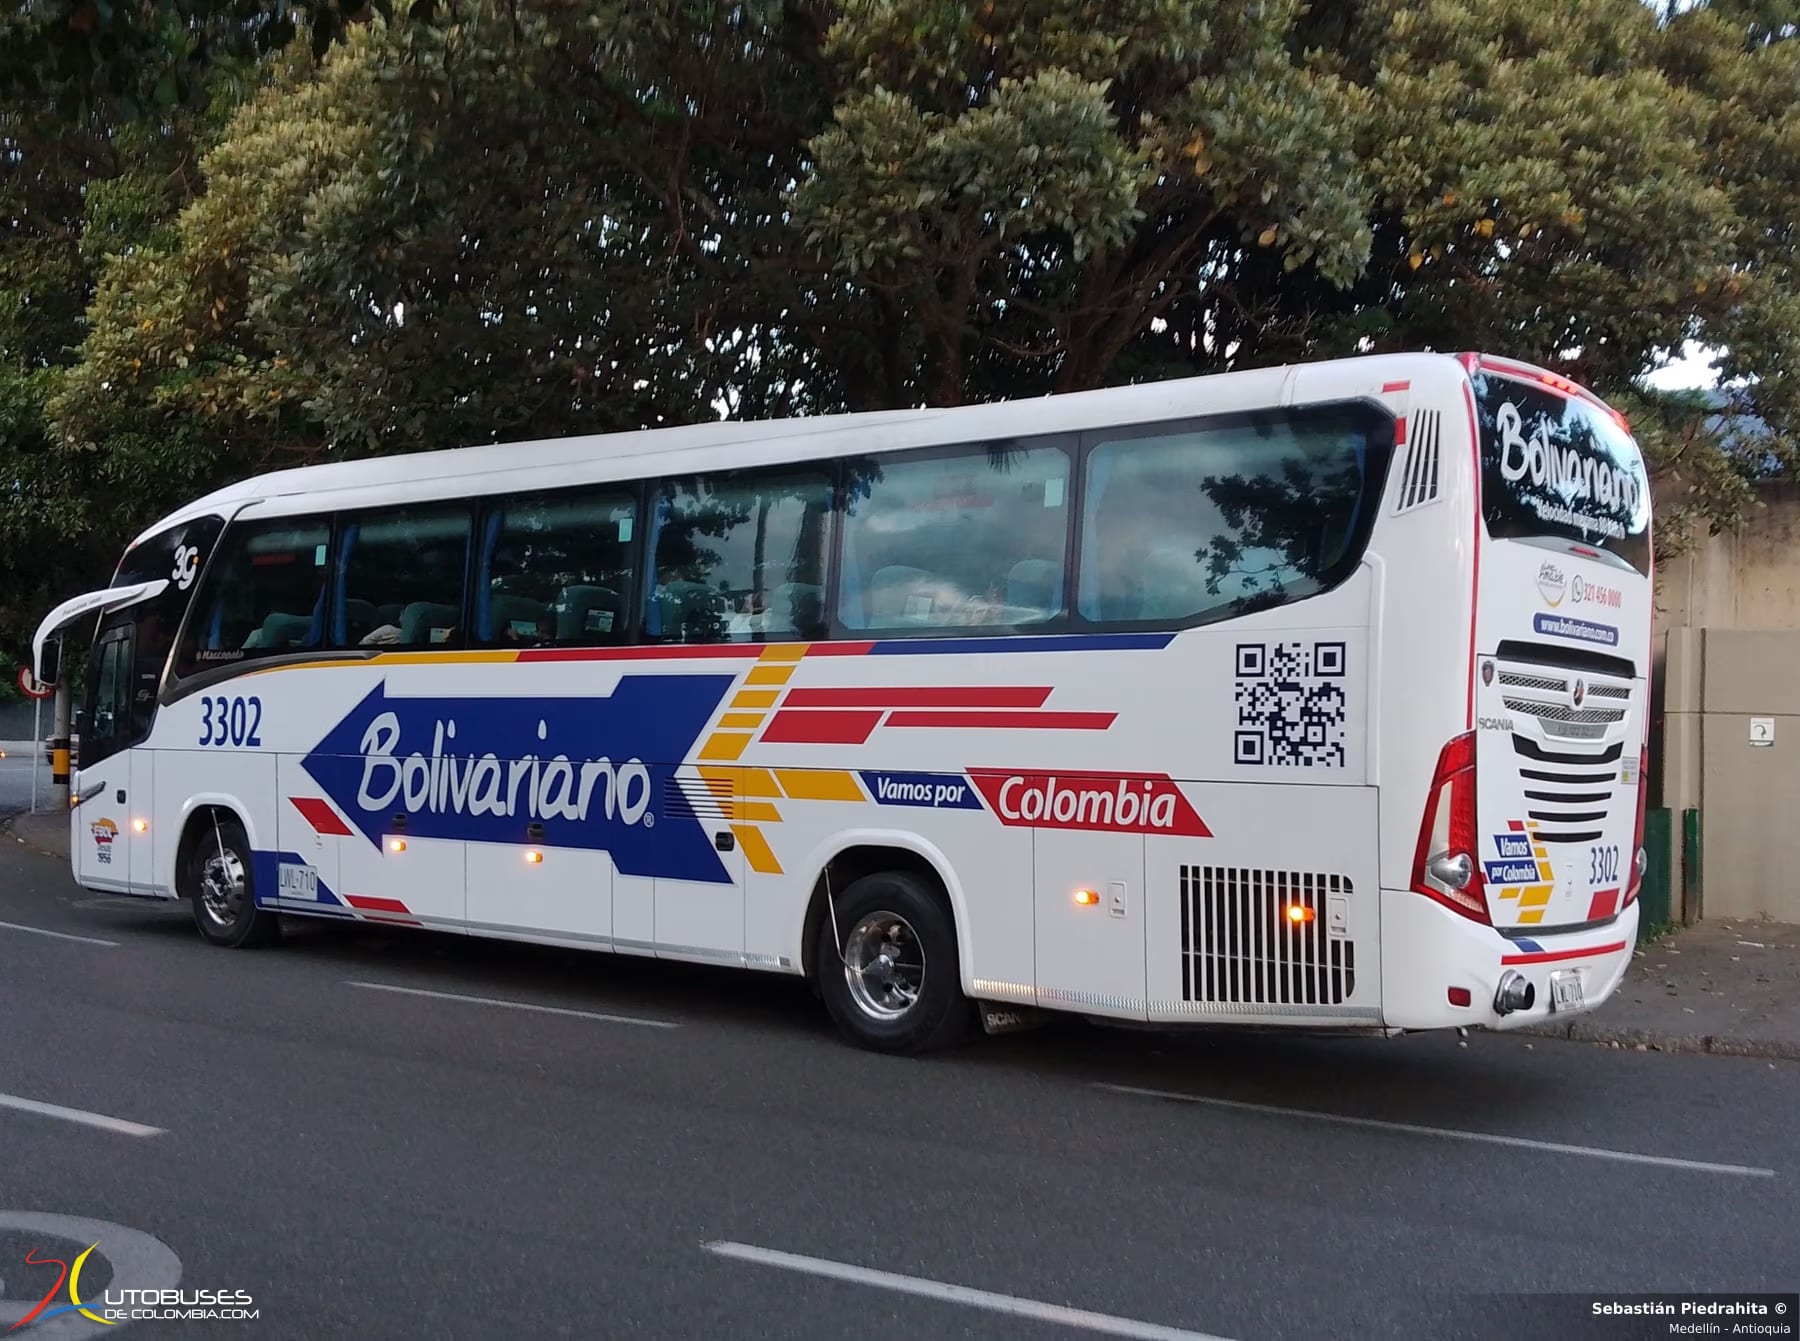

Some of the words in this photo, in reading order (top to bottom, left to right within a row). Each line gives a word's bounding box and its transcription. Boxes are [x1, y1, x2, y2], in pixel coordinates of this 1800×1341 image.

[1496, 402, 1640, 516] Bolivariano
[1583, 583, 1596, 602] 321
[1541, 618, 1614, 642] www.bolivariano.com.co
[199, 696, 262, 746] 3302
[1478, 717, 1514, 731] SCANIA
[357, 711, 651, 825] Bolivariano
[877, 776, 933, 800] Vamos
[934, 783, 966, 806] por
[999, 776, 1176, 827] Colombia
[1500, 837, 1528, 857] Vamos
[1491, 866, 1504, 879] por
[1502, 866, 1535, 881] Colombia
[1589, 845, 1620, 885] 3302
